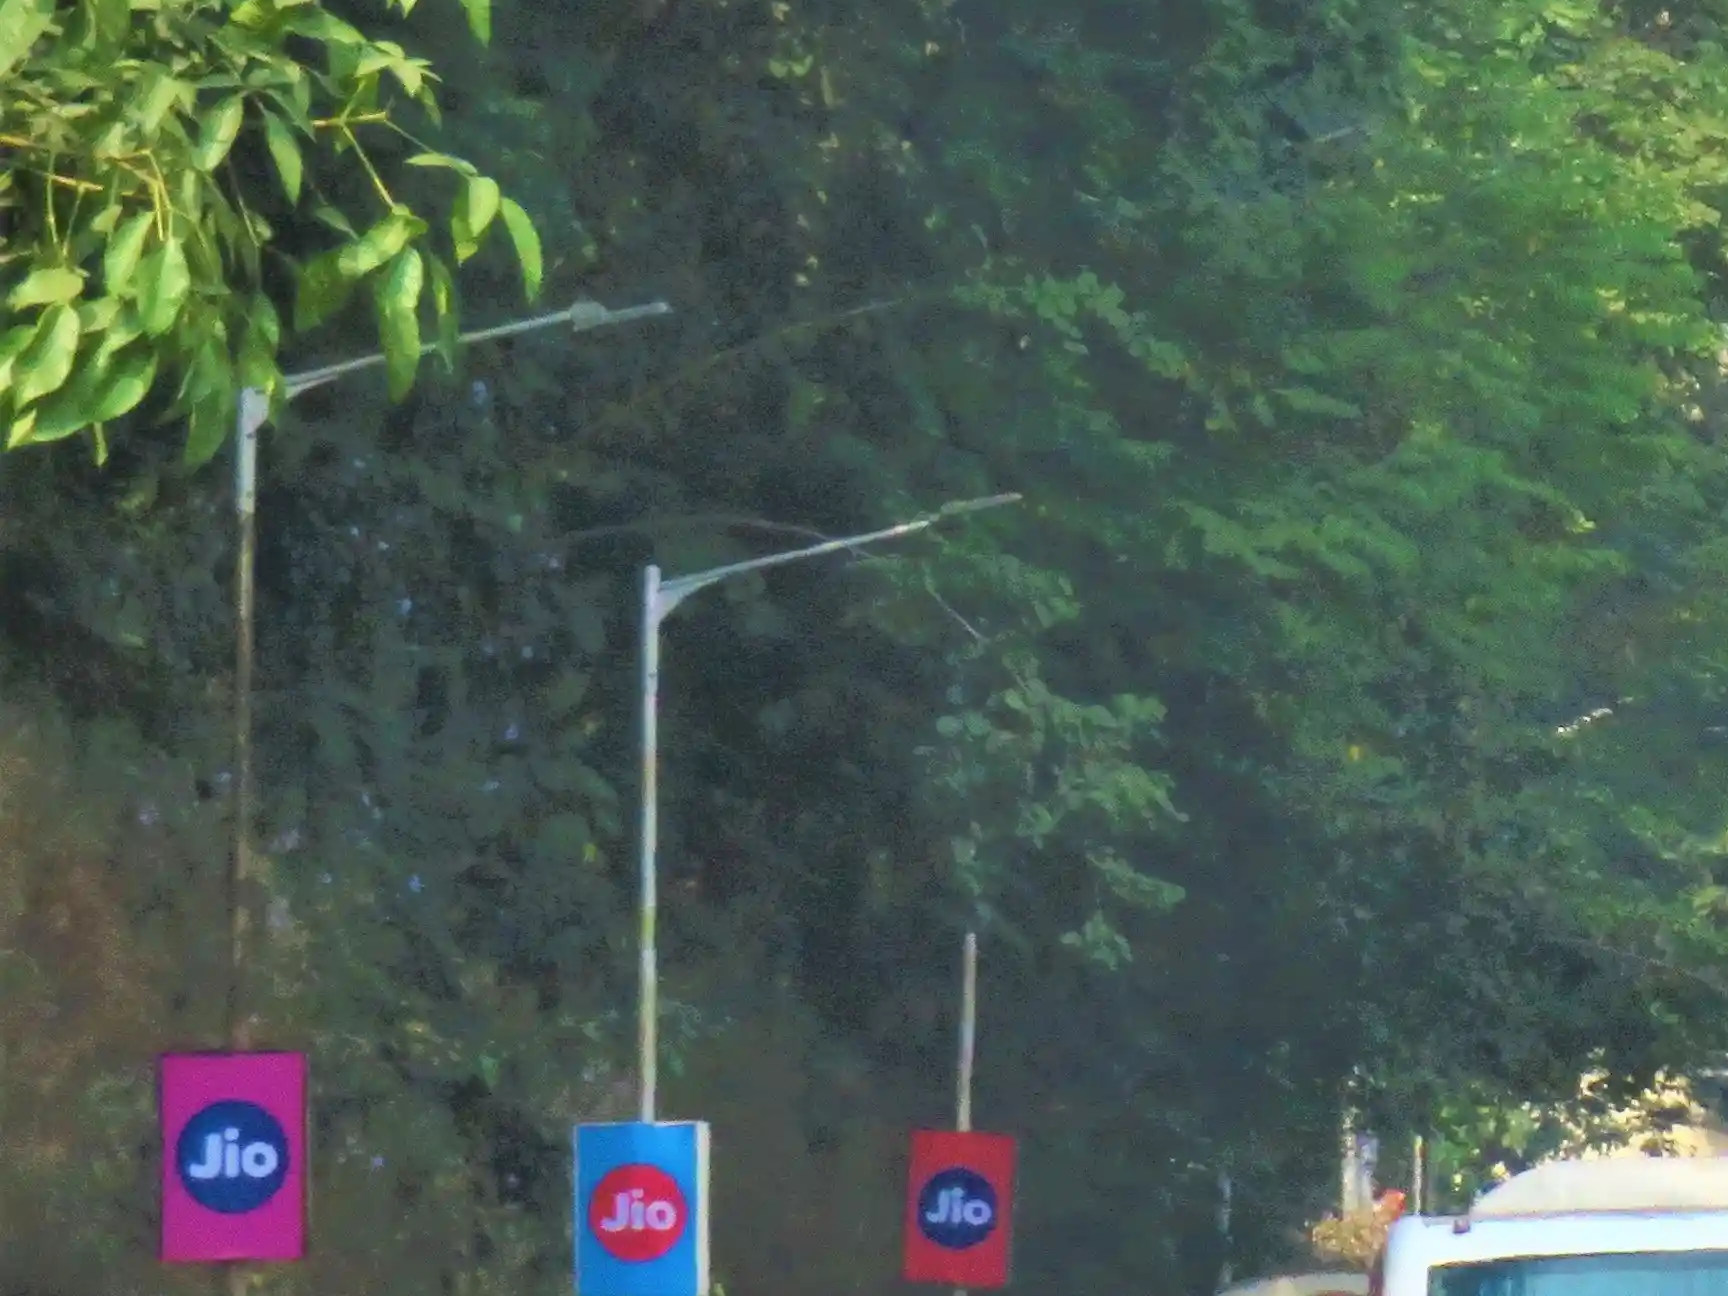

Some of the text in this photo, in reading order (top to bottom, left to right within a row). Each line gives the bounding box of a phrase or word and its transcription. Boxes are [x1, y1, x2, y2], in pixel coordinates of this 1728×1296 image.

[189, 1127, 279, 1179] Jio
[600, 1189, 678, 1233] Jio
[926, 1186, 993, 1226] Jio
